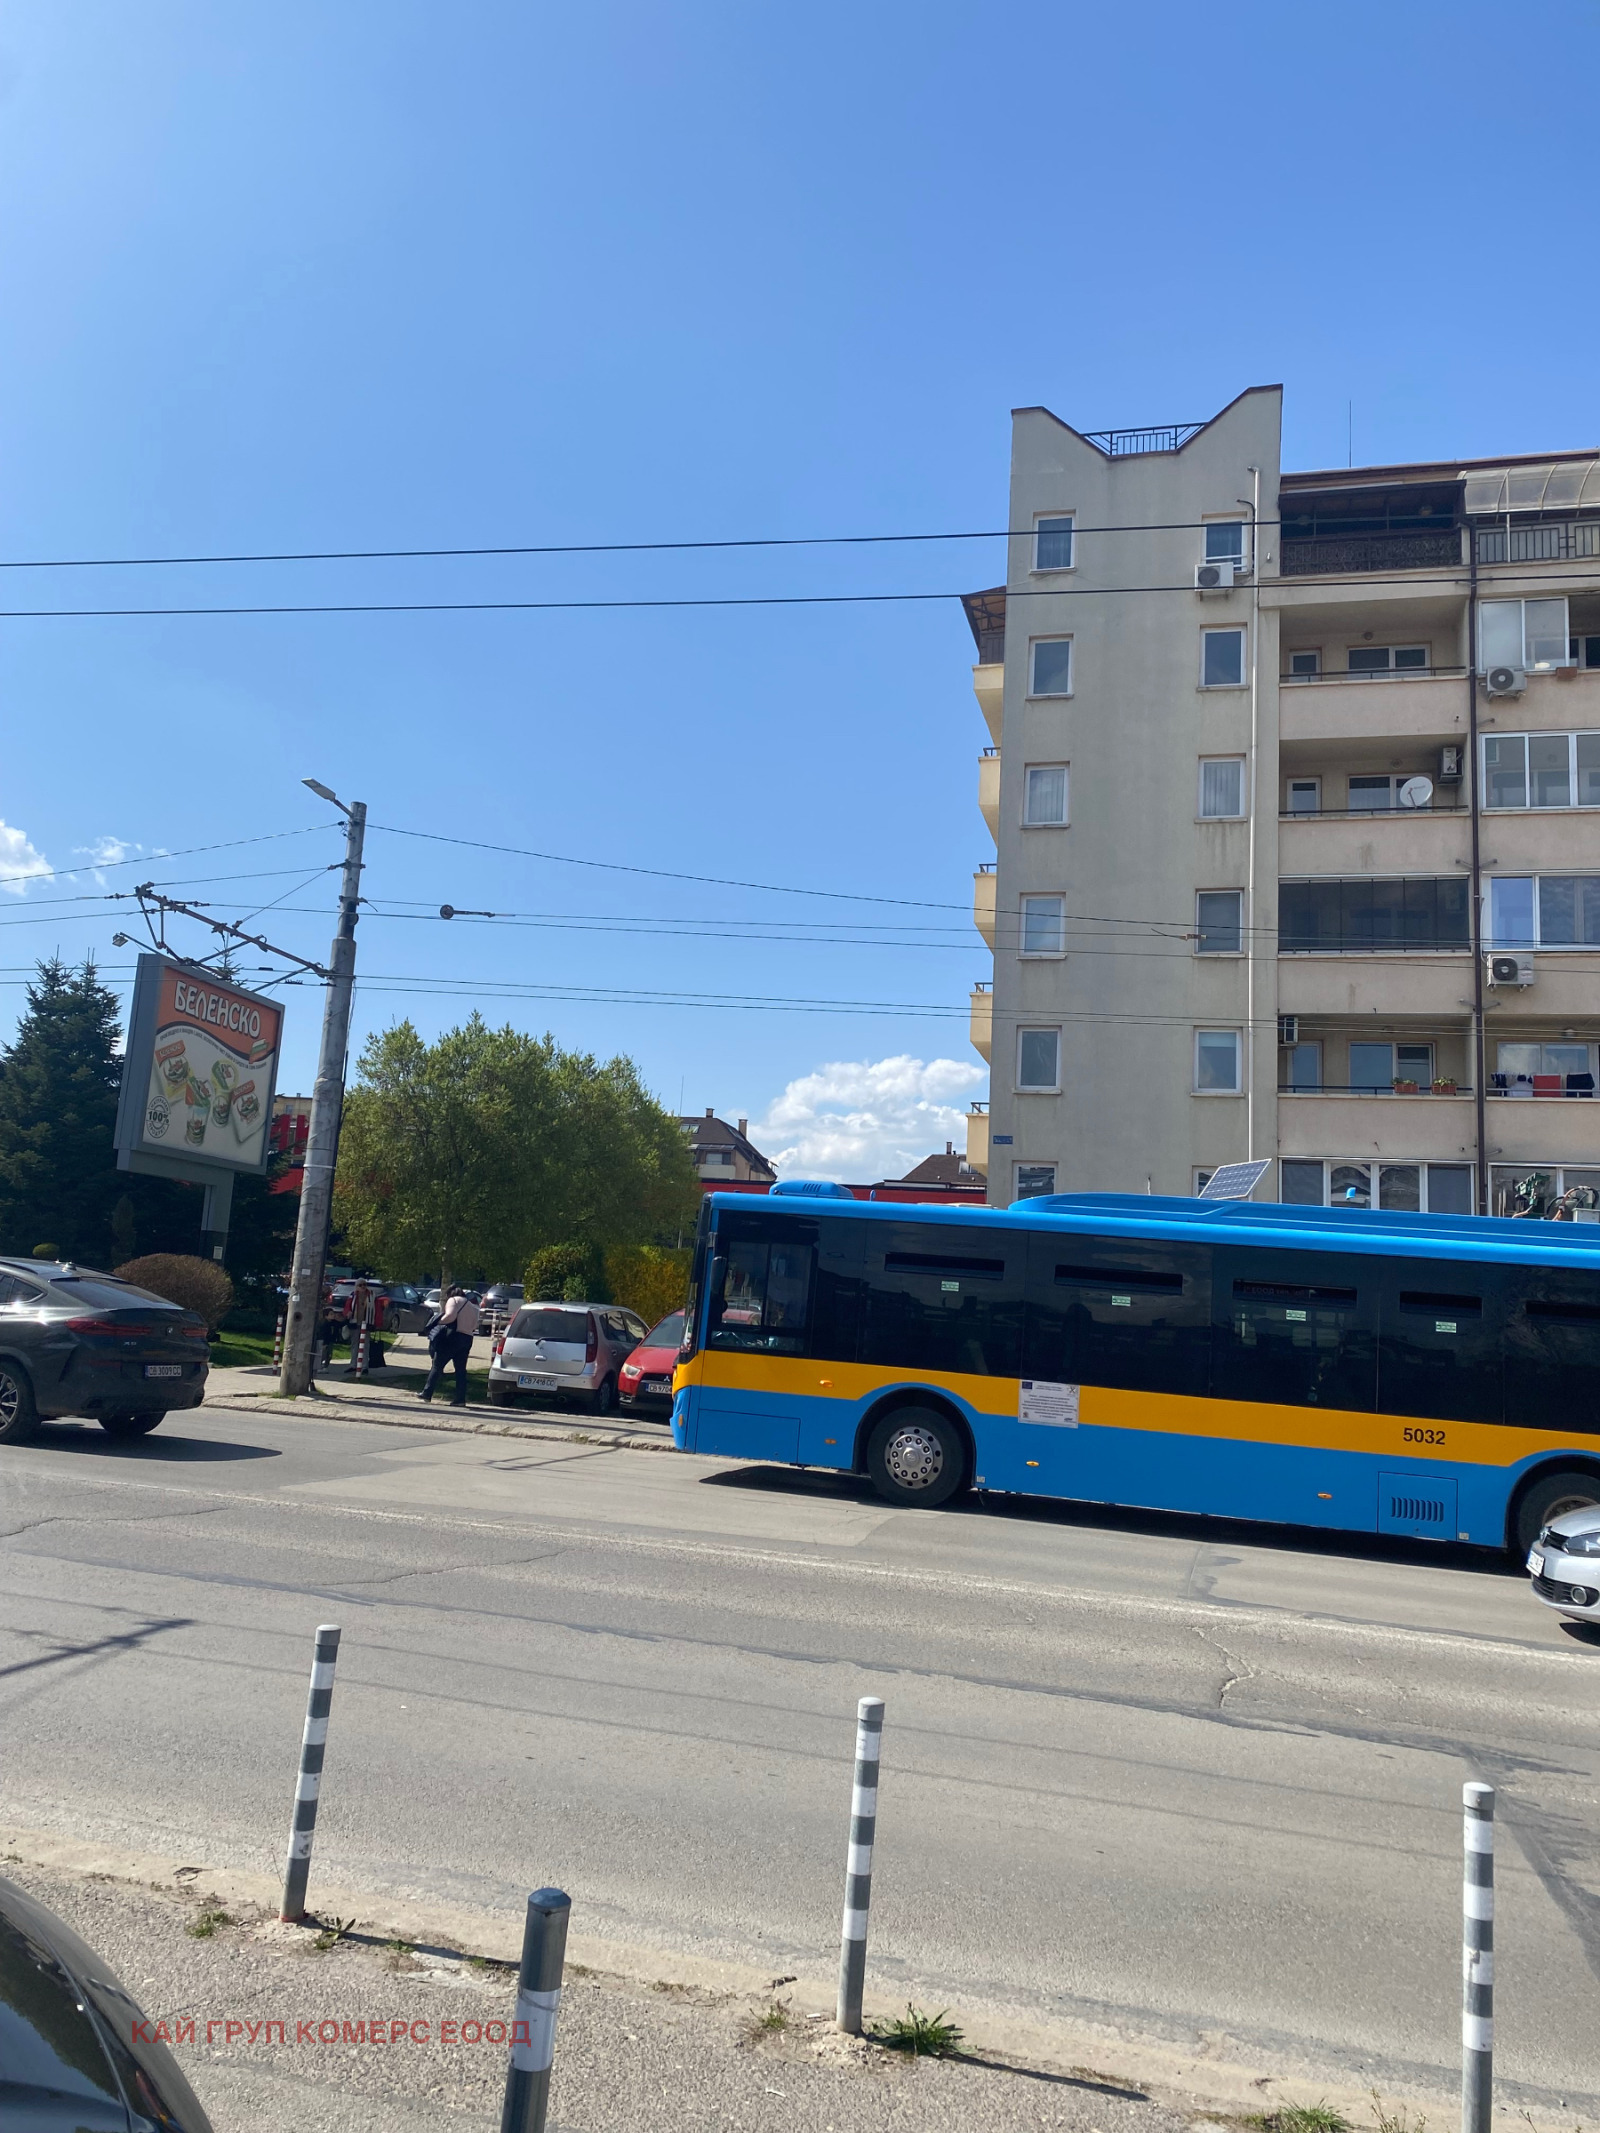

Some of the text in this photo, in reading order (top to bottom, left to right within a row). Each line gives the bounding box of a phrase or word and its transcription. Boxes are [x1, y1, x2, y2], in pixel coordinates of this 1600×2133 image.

[174, 980, 261, 1038] БЕЛЕНСКО
[148, 1111, 170, 1124] 100%
[1403, 1427, 1446, 1445] 5032
